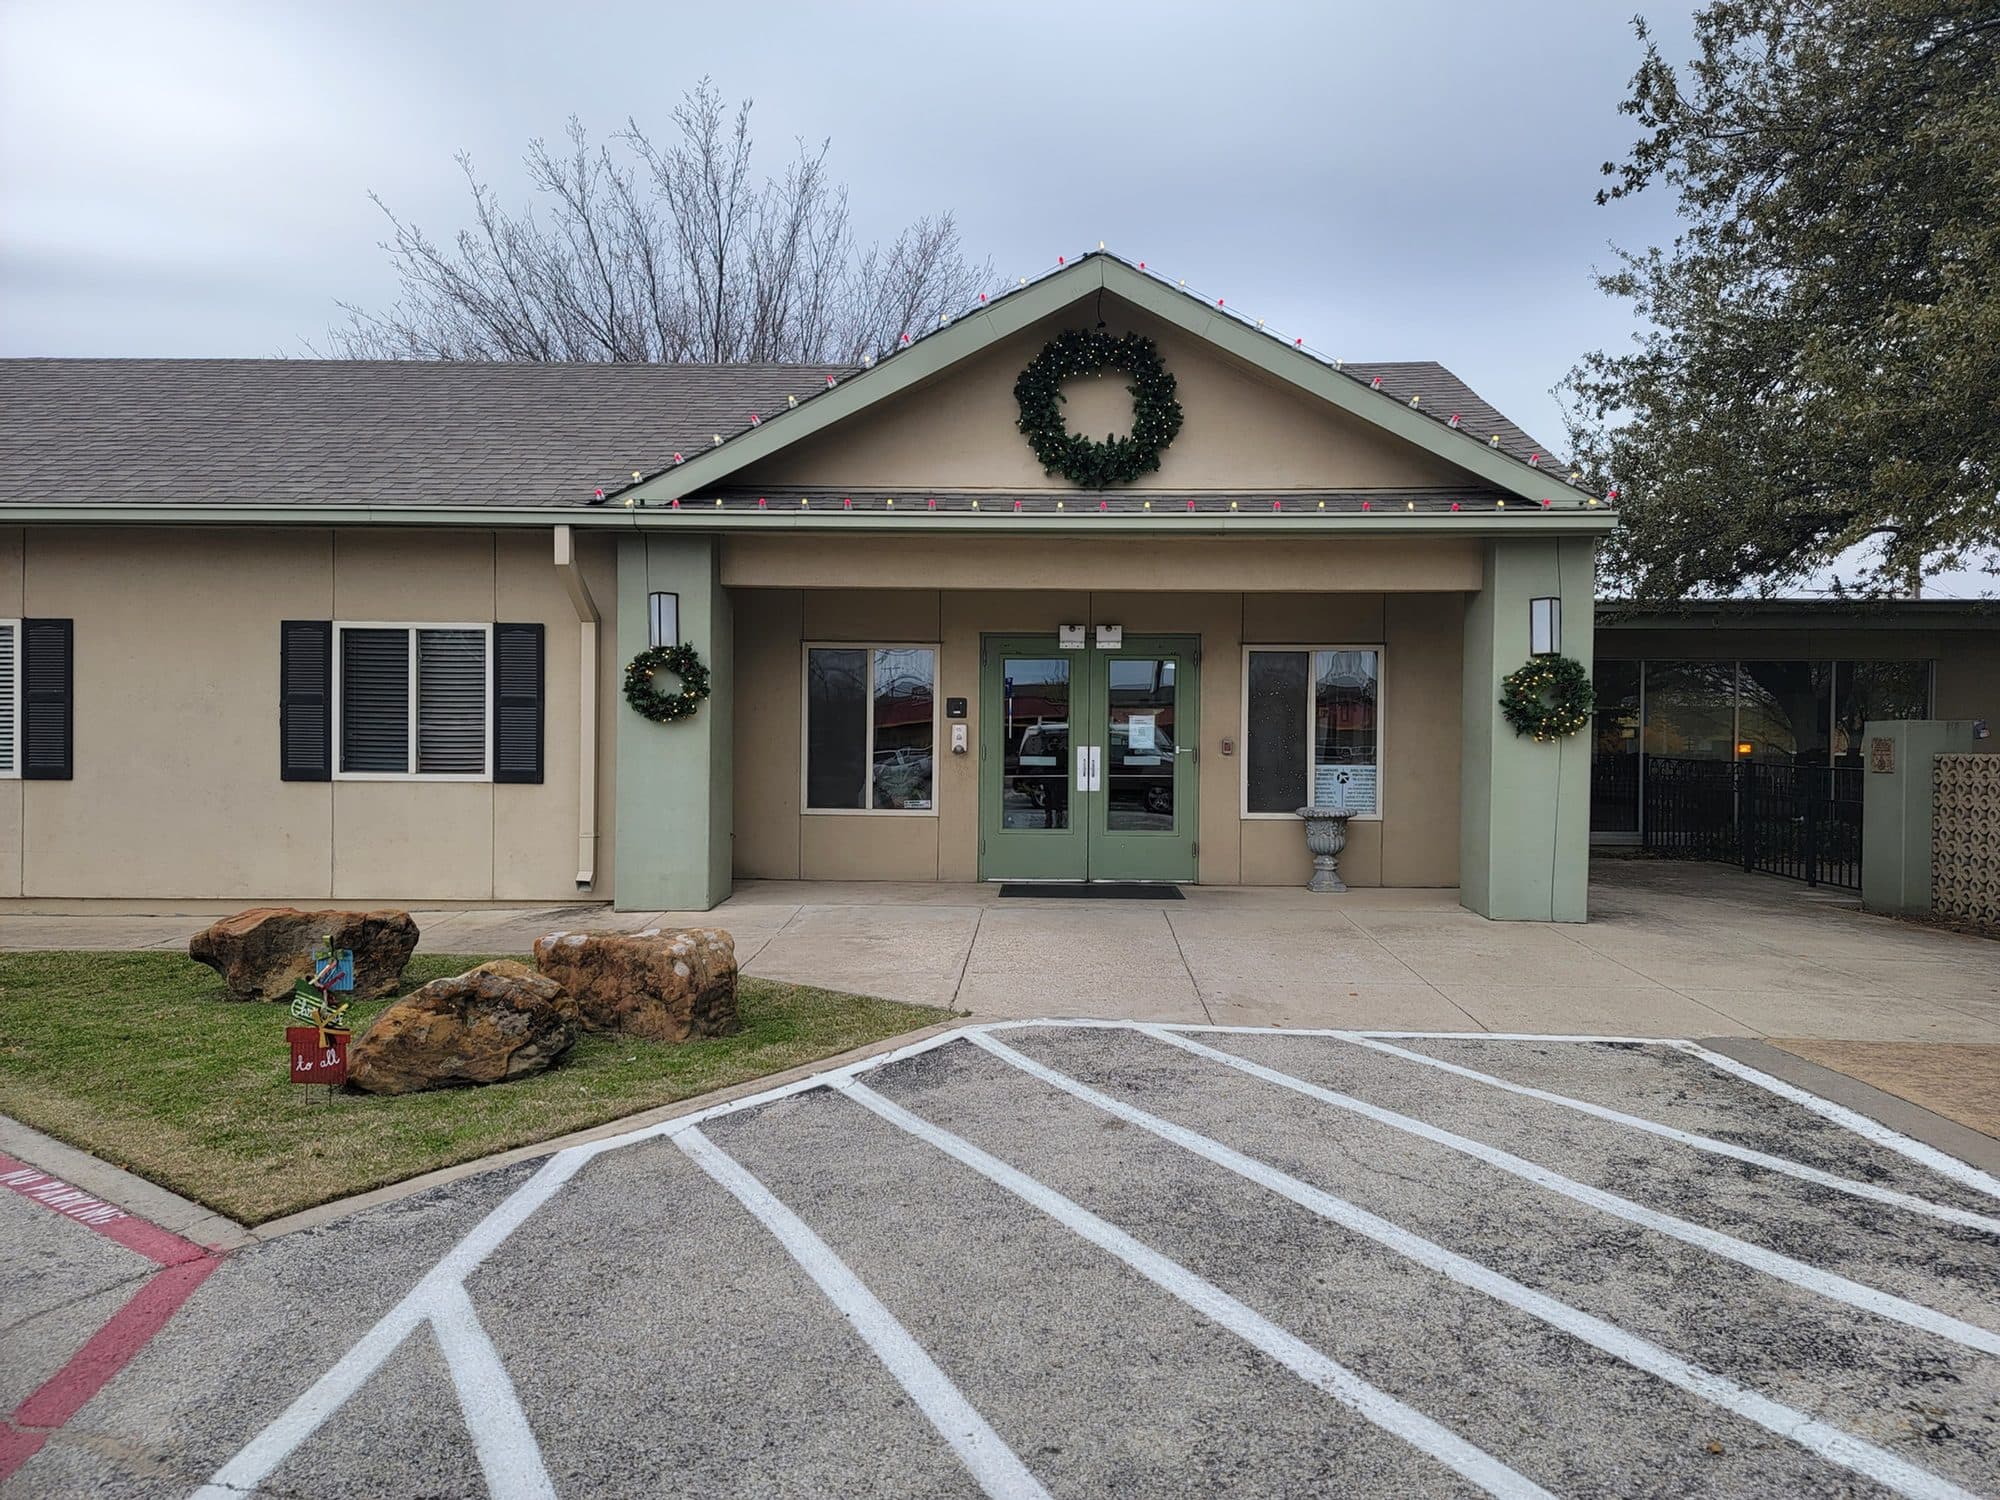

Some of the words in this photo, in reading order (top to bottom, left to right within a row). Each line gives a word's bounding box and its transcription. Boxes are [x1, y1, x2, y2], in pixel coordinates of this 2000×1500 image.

[295, 1054, 314, 1072] to
[319, 1047, 341, 1068] all
[22, 1181, 128, 1225] PARKING
